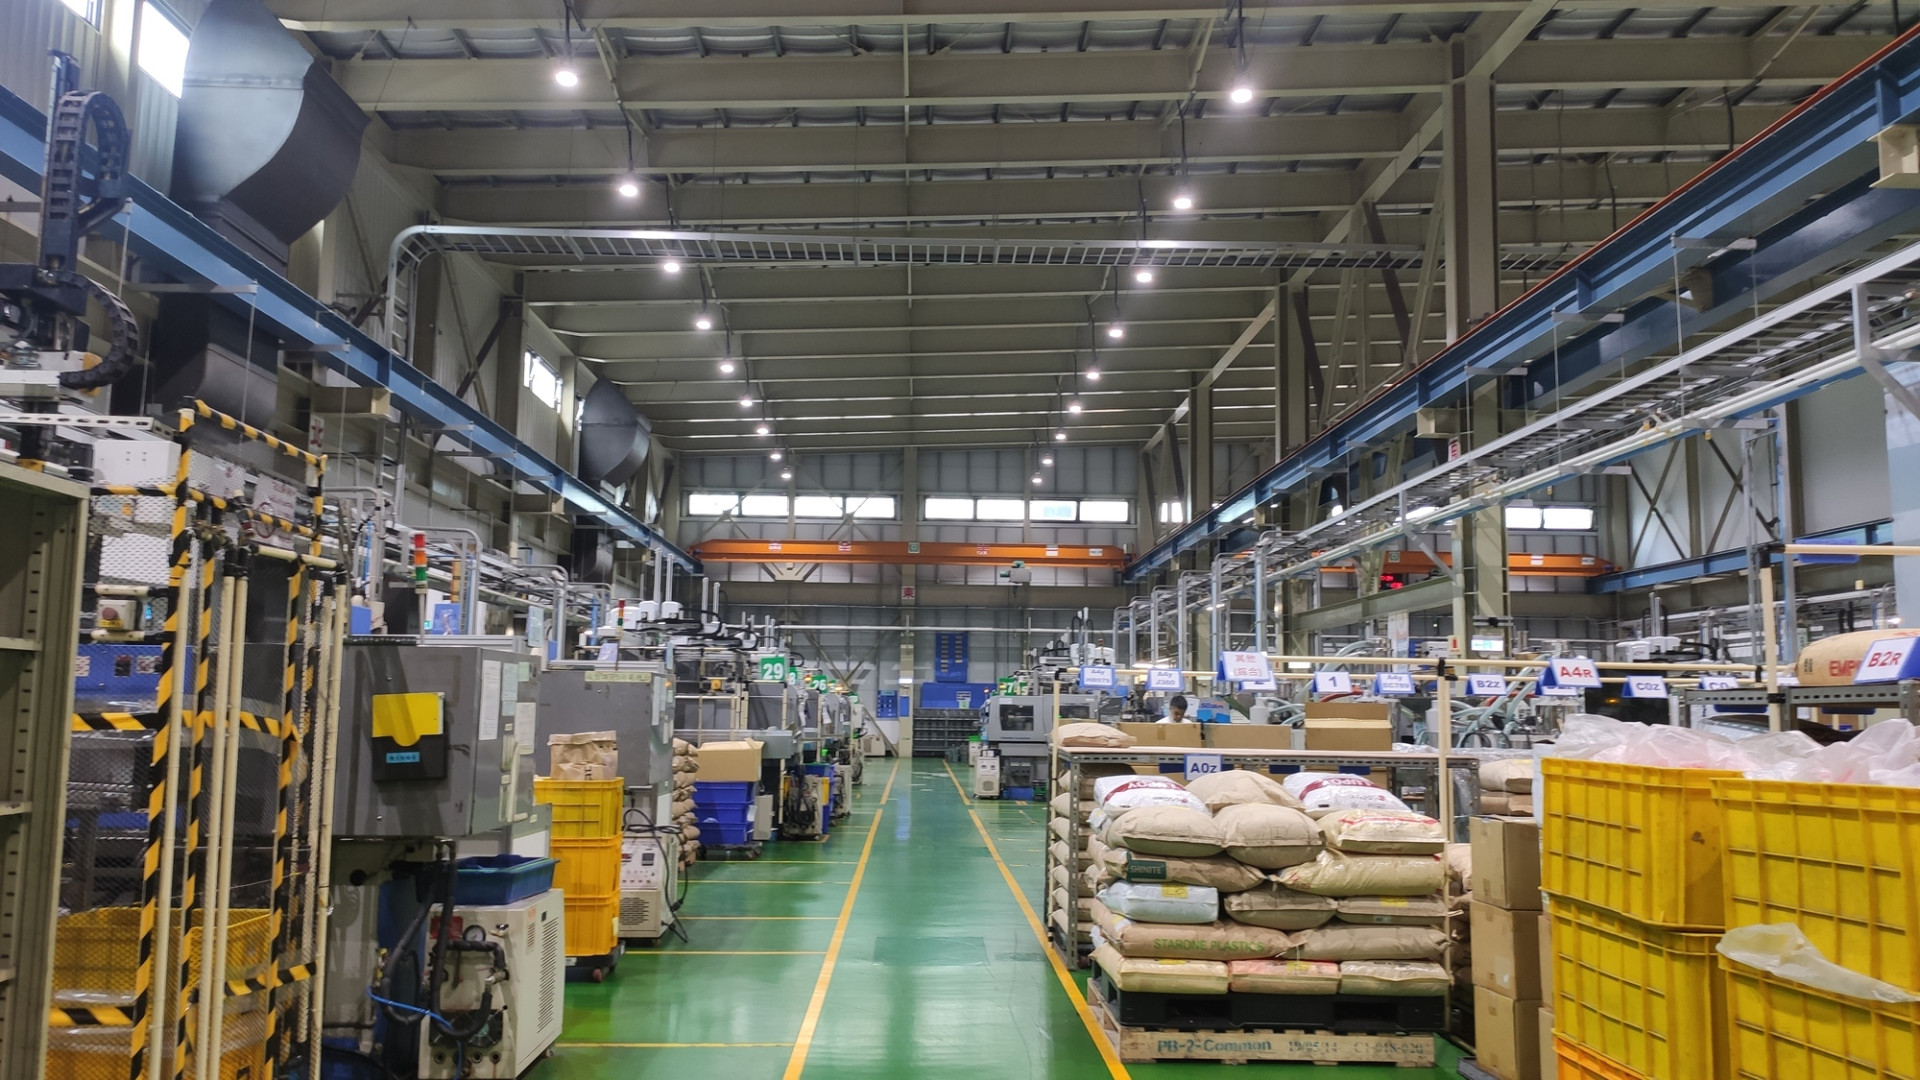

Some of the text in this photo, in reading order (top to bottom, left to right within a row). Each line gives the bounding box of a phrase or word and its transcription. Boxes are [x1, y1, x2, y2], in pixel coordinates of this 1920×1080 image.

[1868, 651, 1902, 668] B2R
[763, 663, 784, 680] 29
[1560, 666, 1593, 678] A4R
[1328, 676, 1337, 687] 1
[1129, 866, 1162, 874] SHINITE
[1154, 938, 1264, 952] STARONE PLASTICS
[1157, 1039, 1272, 1053] PB-2-Common
